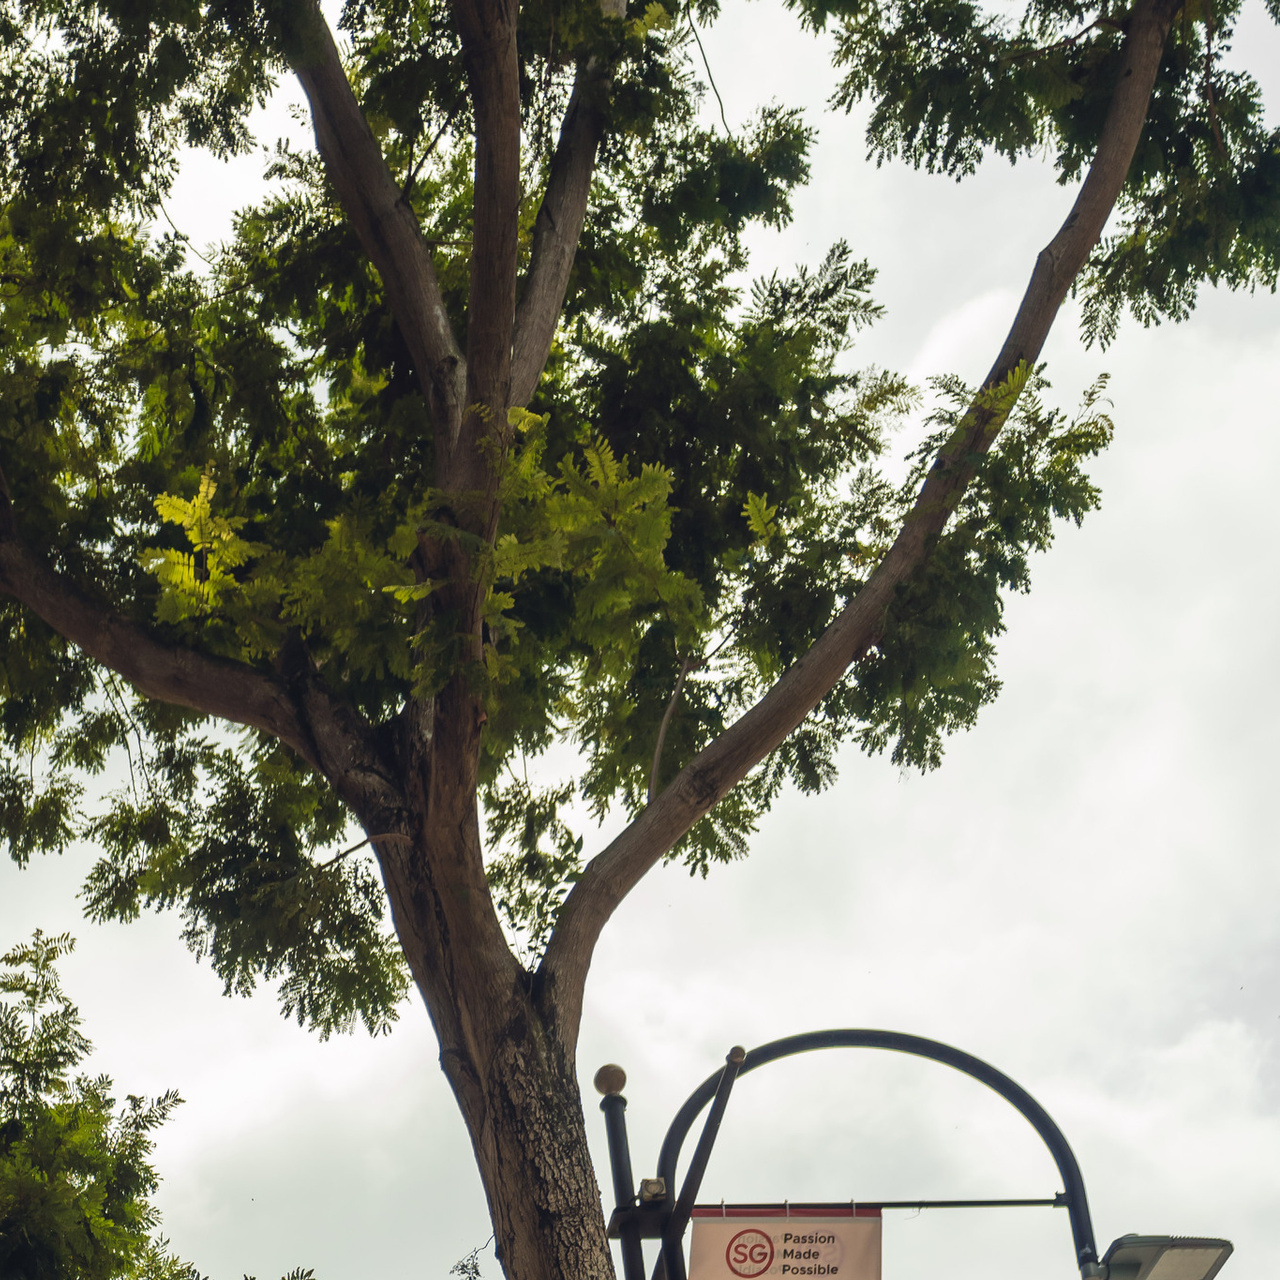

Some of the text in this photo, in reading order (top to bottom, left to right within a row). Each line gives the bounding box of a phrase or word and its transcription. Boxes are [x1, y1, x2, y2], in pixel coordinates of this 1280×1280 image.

[783, 1232, 836, 1244] Passion
[733, 1243, 768, 1264] SG
[782, 1248, 820, 1260] Made
[781, 1263, 839, 1275] Possible
